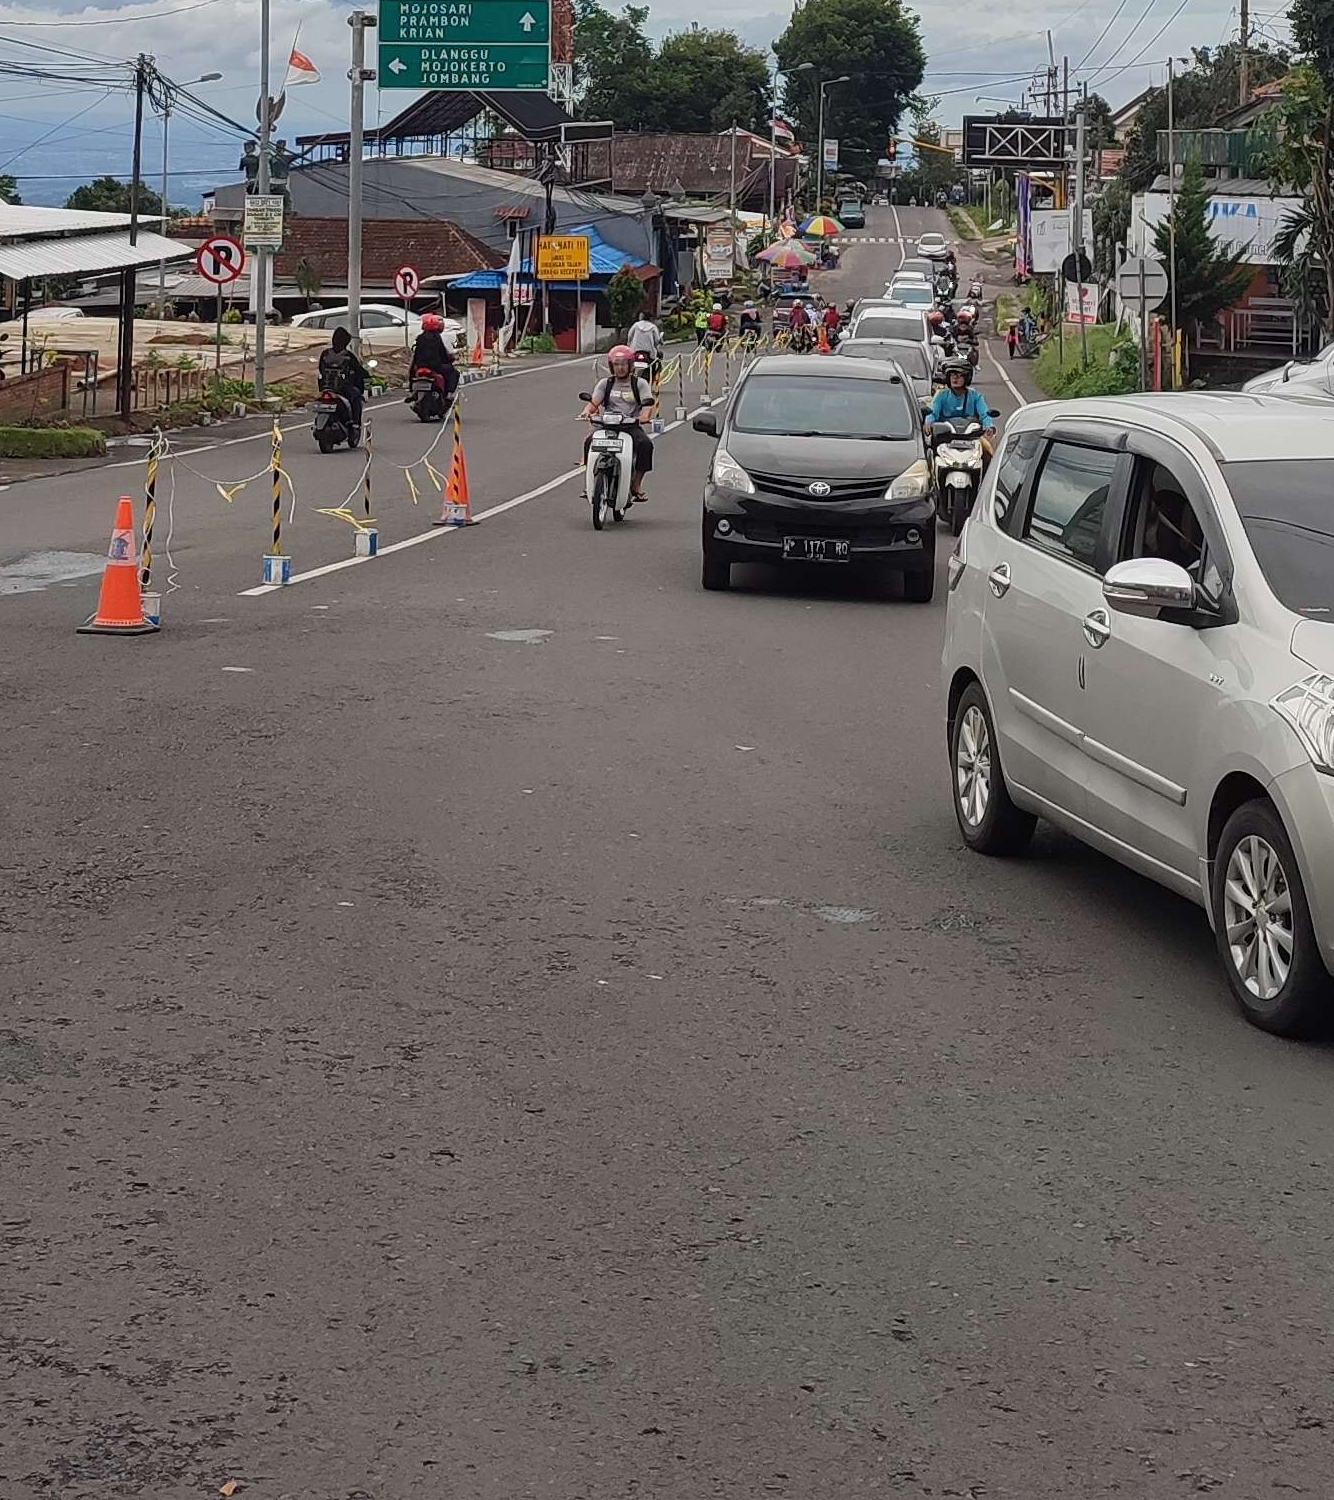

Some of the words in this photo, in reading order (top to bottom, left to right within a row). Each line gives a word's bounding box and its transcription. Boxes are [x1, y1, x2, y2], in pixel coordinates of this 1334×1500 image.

[400, 3, 472, 15] MOJOSARI
[400, 15, 469, 27] PRAMBON
[400, 27, 444, 38] KRIAN
[421, 49, 489, 60] DLANGGU
[420, 61, 506, 72] MOJOKERTO
[420, 73, 490, 84] JOMBANG
